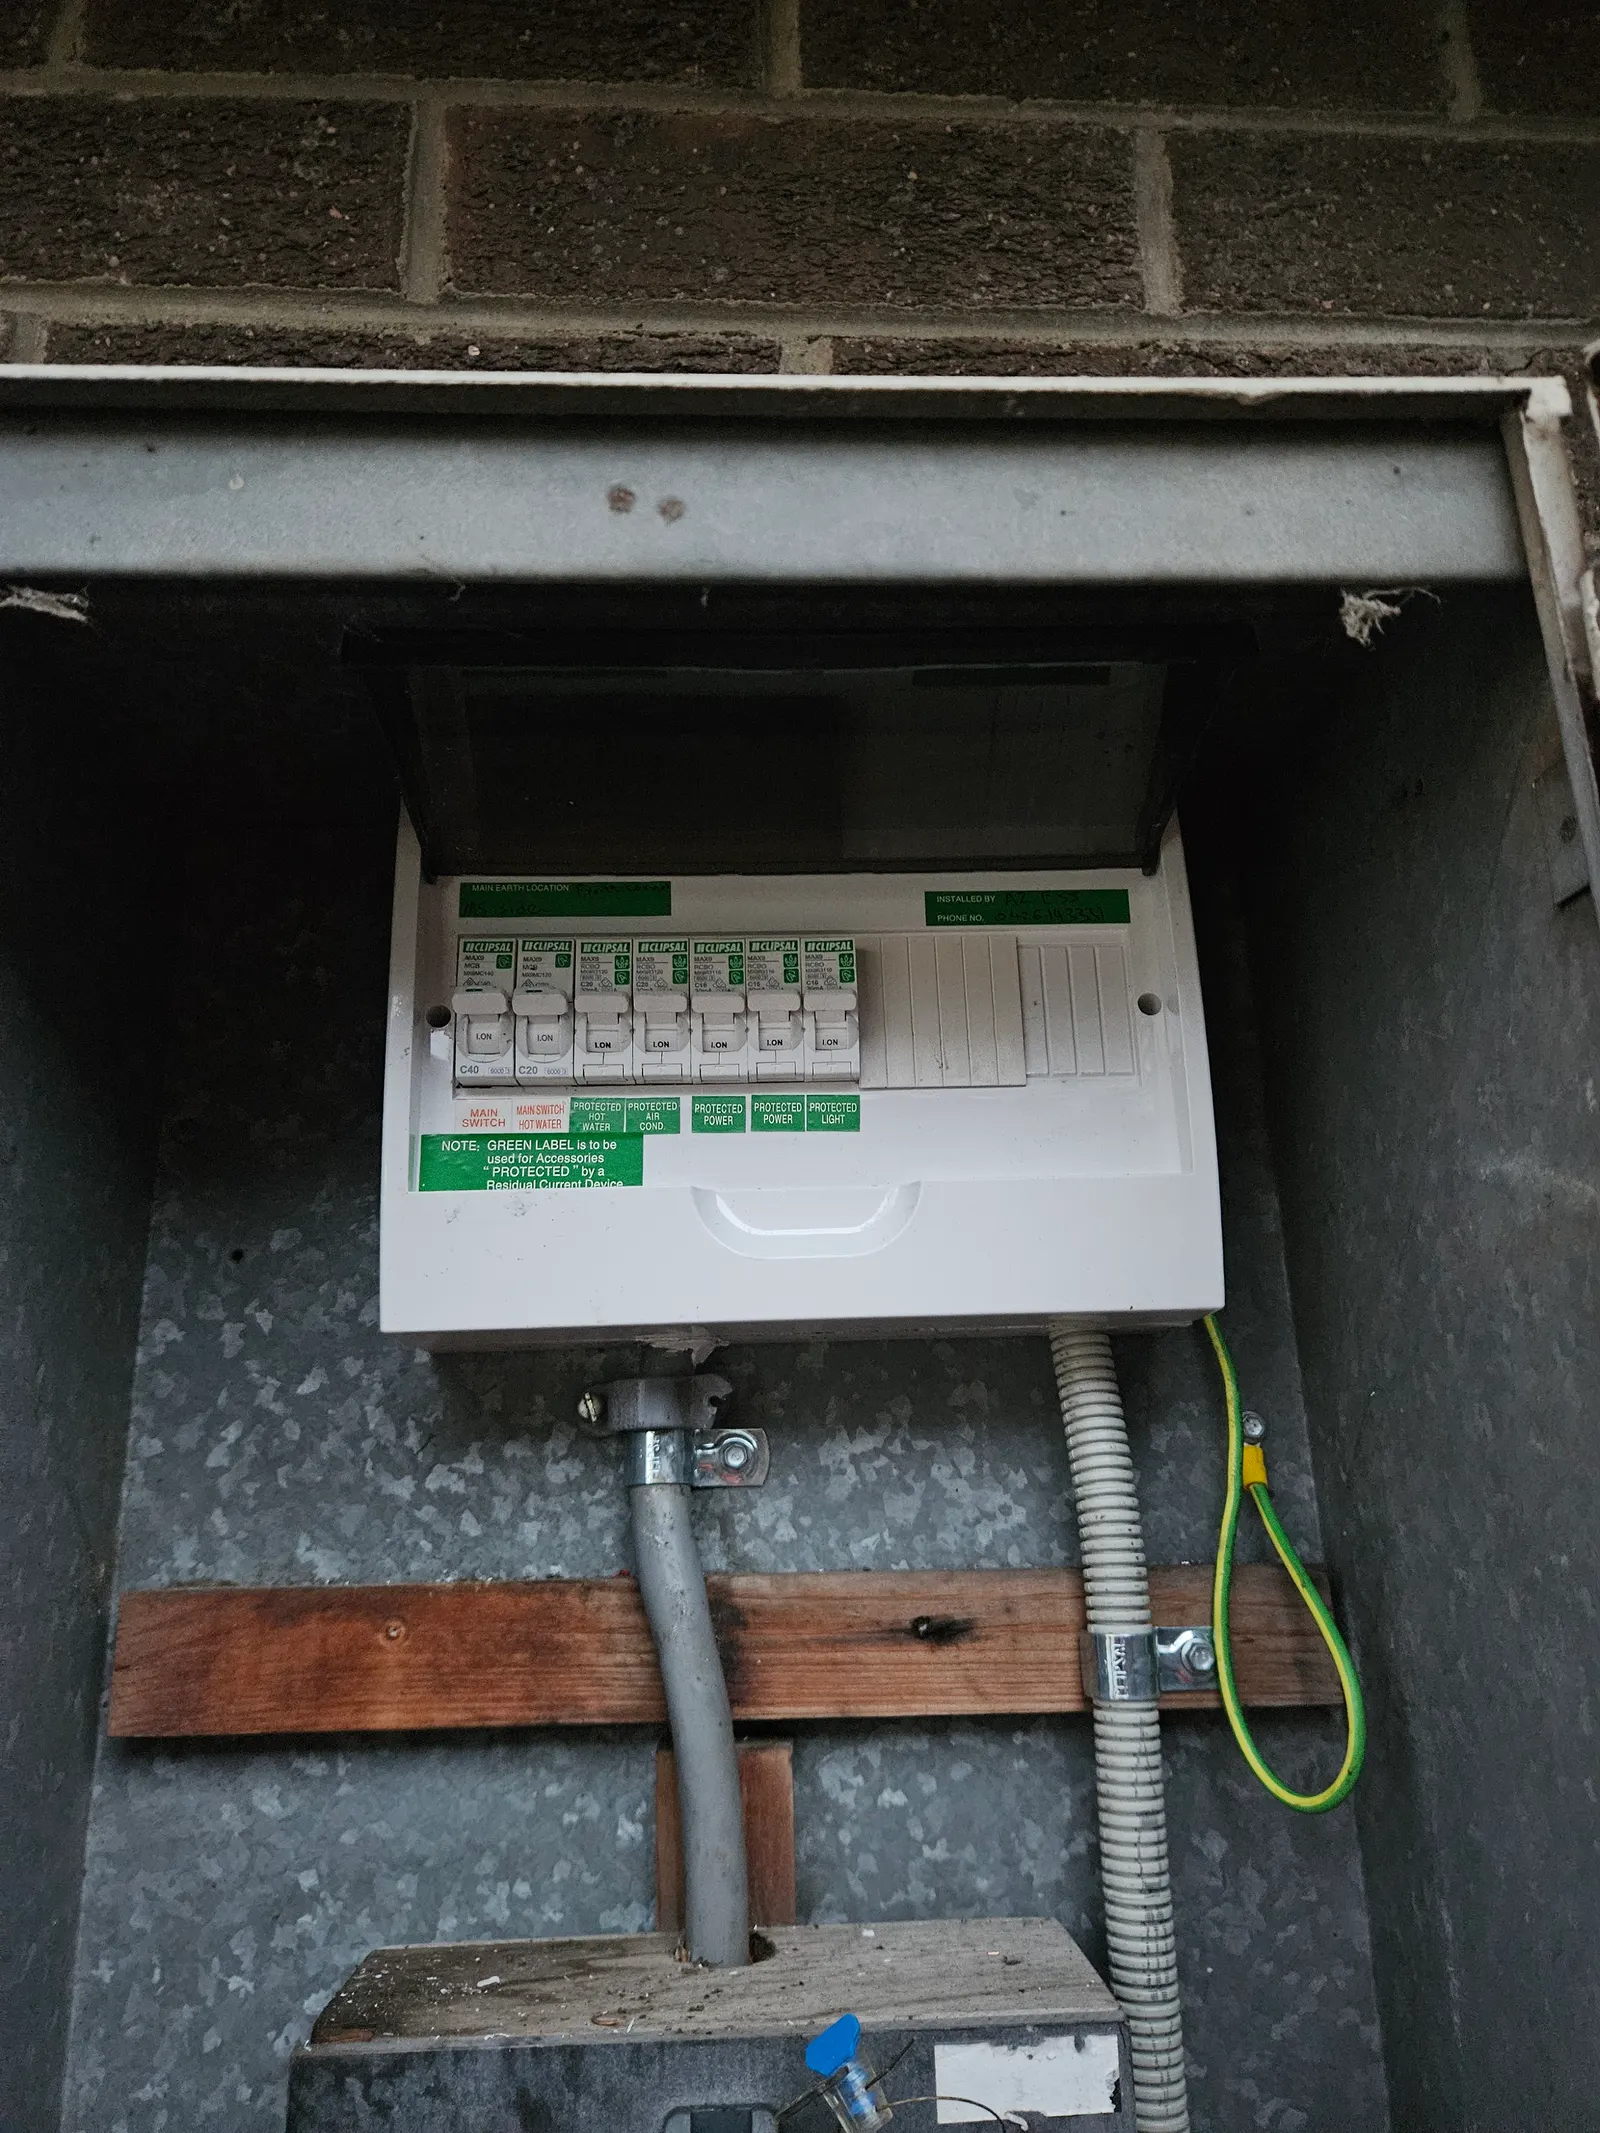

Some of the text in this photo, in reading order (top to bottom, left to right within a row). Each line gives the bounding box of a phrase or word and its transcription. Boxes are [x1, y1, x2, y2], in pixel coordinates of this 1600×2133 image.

[471, 884, 494, 892] MAIN
[495, 884, 525, 892] EARTH
[525, 884, 570, 892] LOCATION
[936, 895, 996, 903] INSTALLED BY
[937, 914, 985, 922] PHONE NO.
[474, 942, 511, 952] CLIPSAL
[532, 941, 570, 951] CLIPSAL
[592, 943, 628, 953] CLIPSAL
[650, 942, 686, 952] CLIPSAL
[704, 943, 742, 953] CLIPSAL
[760, 941, 796, 951] CLIPSAL
[815, 940, 852, 951] CLIPSAL
[460, 1065, 480, 1074] C40
[518, 1065, 538, 1075] C20
[516, 1104, 565, 1115] MAIN SWITCH
[573, 1101, 622, 1112] PROTECTED
[627, 1101, 678, 1111] PROTECTED
[694, 1103, 743, 1114] PROTECTED
[754, 1102, 802, 1113] PROTECTED
[809, 1102, 858, 1113] PROTECTED
[470, 1108, 498, 1118] MAIN
[588, 1112, 605, 1121] HOT
[645, 1112, 660, 1121] AIR
[461, 1118, 506, 1128] SWITCH
[519, 1118, 562, 1130] HOT WATER
[703, 1115, 734, 1126] POWER
[763, 1114, 793, 1124] POWER
[821, 1114, 845, 1124] LIGHT
[582, 1122, 611, 1132] WATER
[639, 1121, 666, 1131] COND.
[441, 1139, 617, 1152] NOTE: GREEN LABEL is to be
[487, 1153, 605, 1164] used for Accessories
[492, 1166, 570, 1177] PROTECTED
[581, 1165, 594, 1179] by
[597, 1168, 605, 1176] a
[486, 1179, 624, 1190] Residual Current Device
